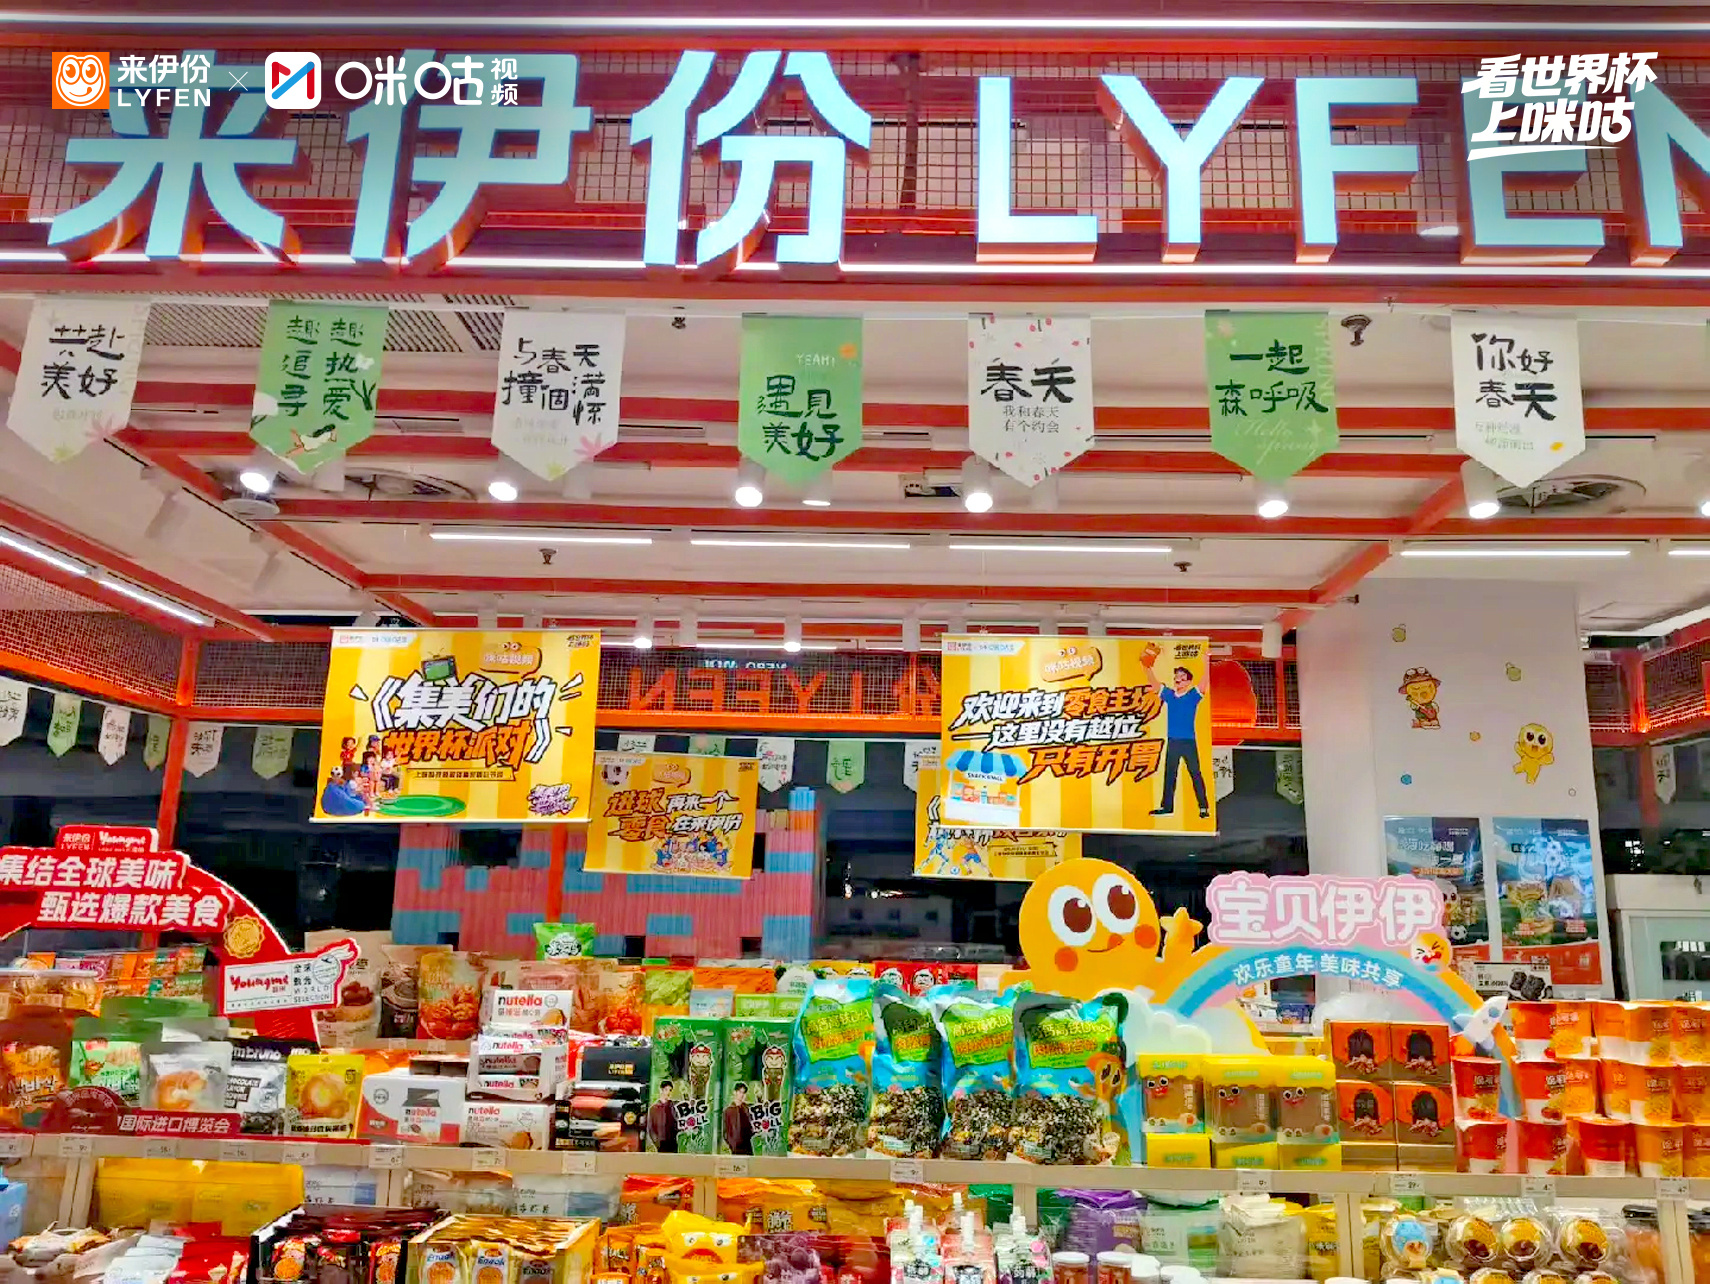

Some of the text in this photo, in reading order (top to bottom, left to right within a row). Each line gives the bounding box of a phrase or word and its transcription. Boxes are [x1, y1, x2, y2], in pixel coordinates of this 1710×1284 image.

[48, 48, 870, 265] 来伊份
[513, 337, 602, 373] 与春天
[1229, 339, 1311, 375] 一起
[1471, 331, 1555, 375] 你好
[41, 362, 118, 400] 美好
[980, 357, 1077, 404] 春天
[1214, 378, 1330, 418] 森呼吸
[1003, 404, 1060, 419] 我和春天
[1475, 378, 1559, 422] 春天
[762, 420, 845, 462] 美好
[1003, 419, 1060, 434] 有个约会
[1017, 740, 1166, 787] 只有开胃
[0, 855, 180, 889] 集结全球美味
[36, 892, 224, 928] 甄选爆款美食
[1217, 880, 1436, 942] 宝贝伊伊
[1233, 952, 1405, 989] 欢乐童年 美味共享
[498, 993, 543, 1007] nutella
[492, 1040, 524, 1050] nutella
[116, 1113, 231, 1135] 国际进口博览会
[468, 1106, 500, 1116] nutella
